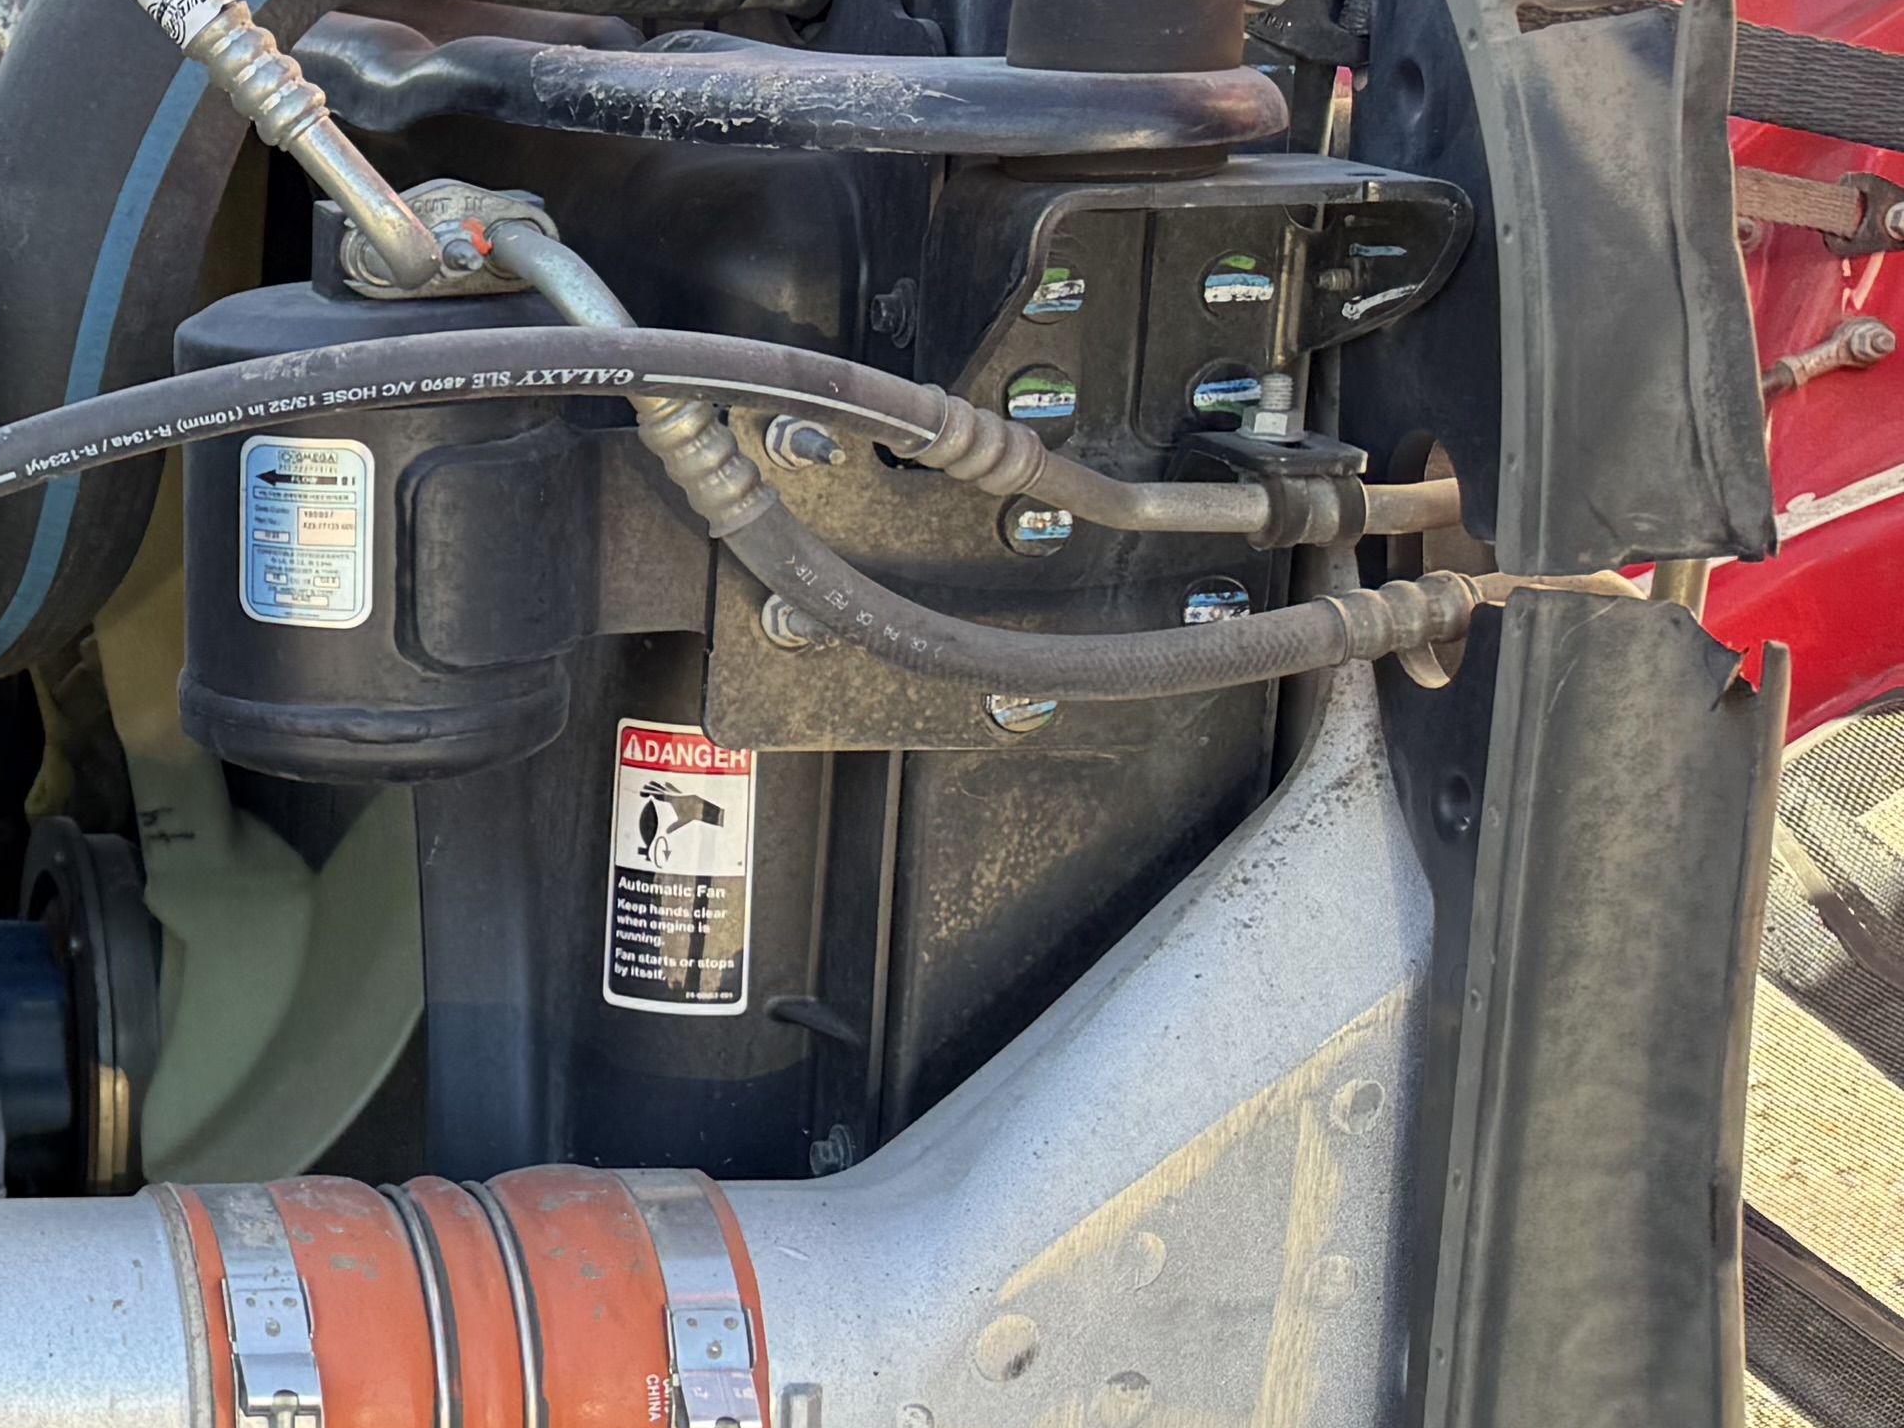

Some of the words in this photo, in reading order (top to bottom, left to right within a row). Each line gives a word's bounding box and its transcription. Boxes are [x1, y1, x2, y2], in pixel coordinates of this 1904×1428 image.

[413, 198, 451, 215] OUT
[472, 371, 511, 390] SLE
[518, 367, 634, 387] GALAXY
[322, 384, 376, 406] HOSE
[381, 378, 414, 399] A/C
[268, 392, 316, 415] 13/32
[177, 404, 243, 433] (10mm)
[111, 423, 171, 448] R-134a
[24, 443, 98, 476] R-1234yf
[644, 743, 747, 769] DANGER
[618, 876, 692, 898] Automatic
[696, 883, 726, 899] Fan
[617, 899, 647, 917] Keep
[649, 901, 690, 918] hands
[693, 903, 727, 919] clear
[616, 915, 647, 929] when
[649, 919, 694, 934] engine
[698, 920, 710, 934] is
[616, 929, 665, 947] running.
[615, 948, 636, 963] Fan
[638, 950, 677, 968] starts
[679, 956, 695, 969] or
[698, 956, 735, 971] stops
[614, 963, 629, 978] by
[630, 964, 666, 982] itself.
[646, 1374, 661, 1421] CHINA
